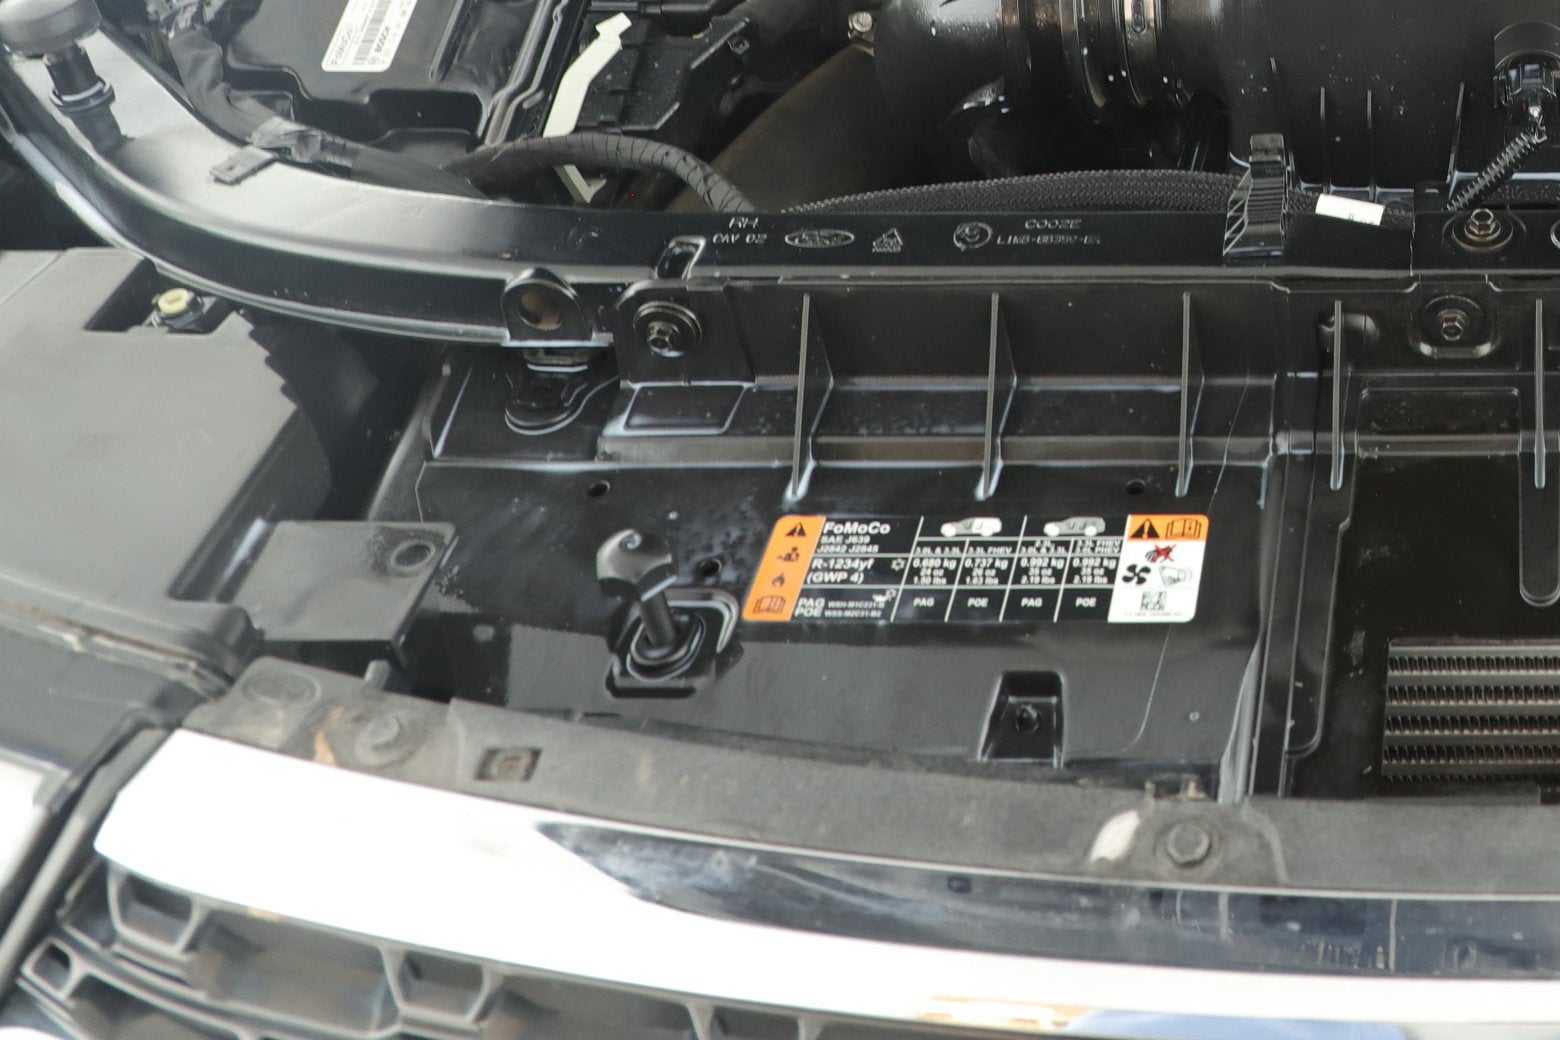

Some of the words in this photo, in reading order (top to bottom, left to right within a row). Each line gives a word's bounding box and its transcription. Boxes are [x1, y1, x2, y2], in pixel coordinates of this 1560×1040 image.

[729, 216, 759, 229] RH
[712, 233, 740, 244] CAV
[745, 233, 768, 244] 02
[823, 521, 891, 535] FoMoCo
[820, 535, 843, 544] SAE
[845, 535, 871, 544] J639
[817, 545, 847, 554] J2842
[848, 545, 879, 554] J2845
[811, 558, 875, 570] R-1234yf
[912, 558, 942, 568] 0.680
[943, 558, 957, 570] kg
[964, 558, 993, 568] 0.737
[994, 558, 1009, 570] kg
[1020, 558, 1049, 567] 0.992
[1050, 558, 1065, 570] kg
[1072, 558, 1101, 567] 0.992
[1102, 558, 1117, 570] kg
[1028, 568, 1040, 576] 35
[1041, 568, 1053, 576] oz
[1080, 568, 1092, 576] 35
[1093, 568, 1105, 576] oz
[806, 571, 848, 585] (GWP
[849, 571, 864, 585] 4)
[932, 576, 947, 585] lbs
[985, 576, 999, 585] lbs
[1041, 576, 1056, 584] lbs
[1093, 576, 1108, 584] lbs
[797, 597, 825, 608] PAG
[913, 597, 935, 607] PAG
[967, 597, 989, 607] POE
[1020, 597, 1043, 607] PAG
[1075, 597, 1097, 607] POE
[794, 607, 823, 617] POE
